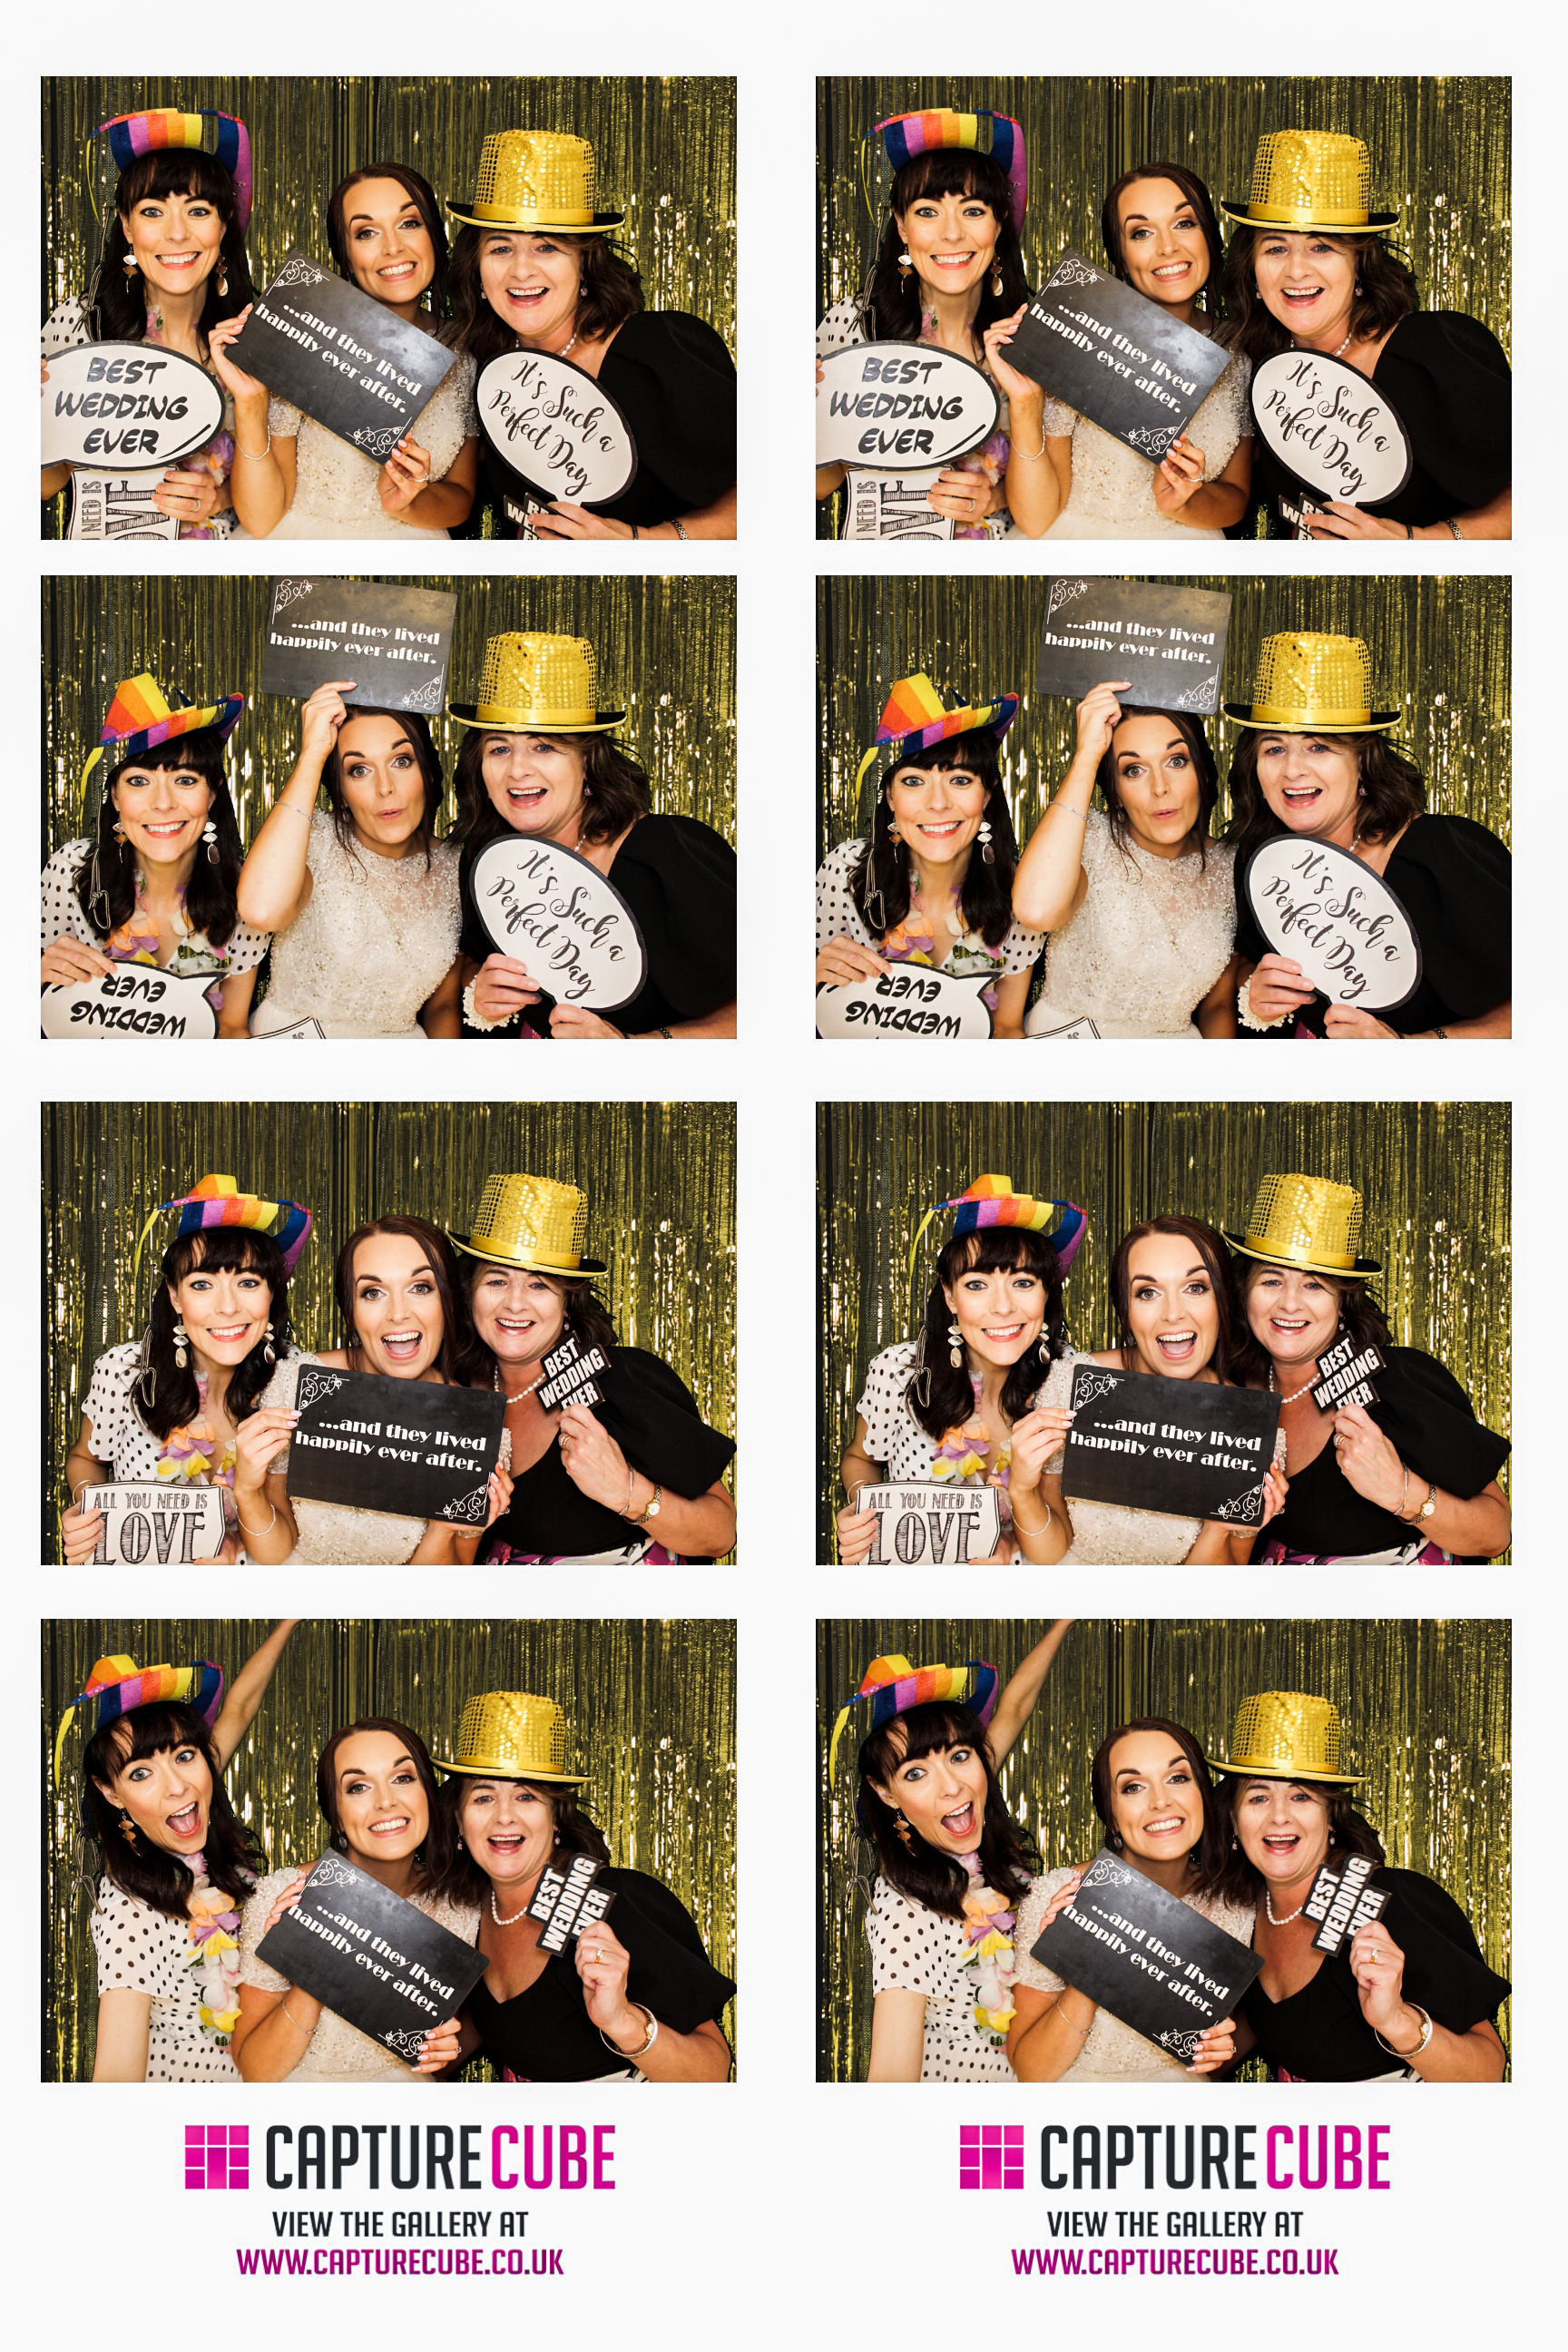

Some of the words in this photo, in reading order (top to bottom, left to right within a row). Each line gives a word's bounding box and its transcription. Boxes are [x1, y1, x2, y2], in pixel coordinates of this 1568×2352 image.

[86, 357, 168, 386] BEST
[254, 302, 323, 352] happily
[321, 350, 361, 379] ever
[359, 375, 407, 414] after.
[283, 304, 338, 340] ...and
[337, 333, 377, 365] they
[375, 358, 423, 397] lived
[861, 357, 943, 386] BEST
[1029, 302, 1098, 352] happily
[1096, 350, 1136, 379] ever
[1134, 375, 1181, 414] after.
[1058, 304, 1113, 340] ...and
[1112, 333, 1152, 365] they
[1150, 358, 1198, 397] lived
[54, 390, 189, 420] WEDDING
[511, 359, 546, 399] It's
[542, 386, 604, 443] Such
[599, 435, 615, 452] a
[829, 390, 964, 420] WEDDING
[1286, 359, 1321, 399] It's
[1317, 386, 1379, 443] Such
[1374, 435, 1390, 452] a
[83, 427, 160, 456] EVER
[488, 389, 554, 451] Perfect
[547, 435, 592, 496] Day
[858, 427, 935, 456] EVER
[1263, 389, 1328, 451] Perfect
[1322, 435, 1367, 496] Day
[82, 480, 102, 494] IS
[857, 480, 877, 494] IS
[82, 499, 102, 533] NEED
[857, 499, 877, 533] NEED
[270, 632, 342, 652] happily
[344, 642, 384, 656] ever
[387, 647, 437, 664] after.
[291, 619, 348, 633] ...and
[351, 622, 392, 639] they
[395, 628, 440, 645] lived
[1044, 632, 1117, 652] happily
[1119, 642, 1159, 656] ever
[1161, 647, 1212, 664] after.
[1066, 619, 1122, 633] ...and
[1126, 622, 1167, 639] they
[1170, 628, 1215, 645] lived
[517, 849, 558, 895] It's
[550, 887, 619, 949] Such
[609, 945, 626, 961] a
[1292, 849, 1333, 895] It's
[1325, 887, 1394, 949] Such
[1384, 945, 1401, 961] a
[486, 876, 559, 948] Perfect
[549, 936, 596, 1000] Day
[1261, 876, 1334, 948] Perfect
[1324, 936, 1371, 1000] Day
[101, 972, 166, 1003] EVER
[876, 972, 941, 1003] EVER
[70, 1001, 186, 1039] WEDDING
[845, 1001, 961, 1039] WEDDING
[538, 1348, 605, 1408] WEDDING
[544, 1338, 579, 1378] BEST
[1313, 1348, 1380, 1408] WEDDING
[1318, 1338, 1354, 1378] BEST
[295, 1430, 375, 1455] happily
[377, 1446, 423, 1463] ever
[426, 1452, 483, 1472] after.
[318, 1418, 381, 1436] ...and
[386, 1424, 432, 1443] they
[435, 1430, 487, 1451] lived
[1070, 1430, 1150, 1455] happily
[1152, 1446, 1198, 1463] ever
[1200, 1452, 1258, 1472] after.
[1093, 1418, 1156, 1436] ...and
[1161, 1424, 1207, 1443] they
[1210, 1430, 1262, 1451] lived
[93, 1493, 117, 1509] ALL
[124, 1493, 152, 1509] YOU
[157, 1493, 190, 1509] NEED
[195, 1494, 208, 1509] IS
[868, 1493, 892, 1509] ALL
[899, 1493, 926, 1509] YOU
[932, 1493, 965, 1509] NEED
[970, 1494, 983, 1509] IS
[93, 1512, 206, 1565] LOVE
[867, 1512, 981, 1565] LOVE
[530, 1867, 566, 1922] BEST
[541, 1857, 598, 1952] WEDDING
[1305, 1867, 1341, 1922] BEST
[1316, 1857, 1373, 1952] WEDDING
[287, 1904, 357, 1955] happily
[355, 1953, 395, 1983] ever
[392, 1979, 438, 2017] after.
[317, 1905, 372, 1943] ...and
[370, 1936, 411, 1967] they
[408, 1963, 455, 2000] lived
[1062, 1904, 1132, 1955] happily
[1130, 1953, 1170, 1983] ever
[1167, 1979, 1213, 2017] after.
[1092, 1905, 1147, 1943] ...and
[1145, 1936, 1186, 1967] they
[1183, 1963, 1230, 2000] lived
